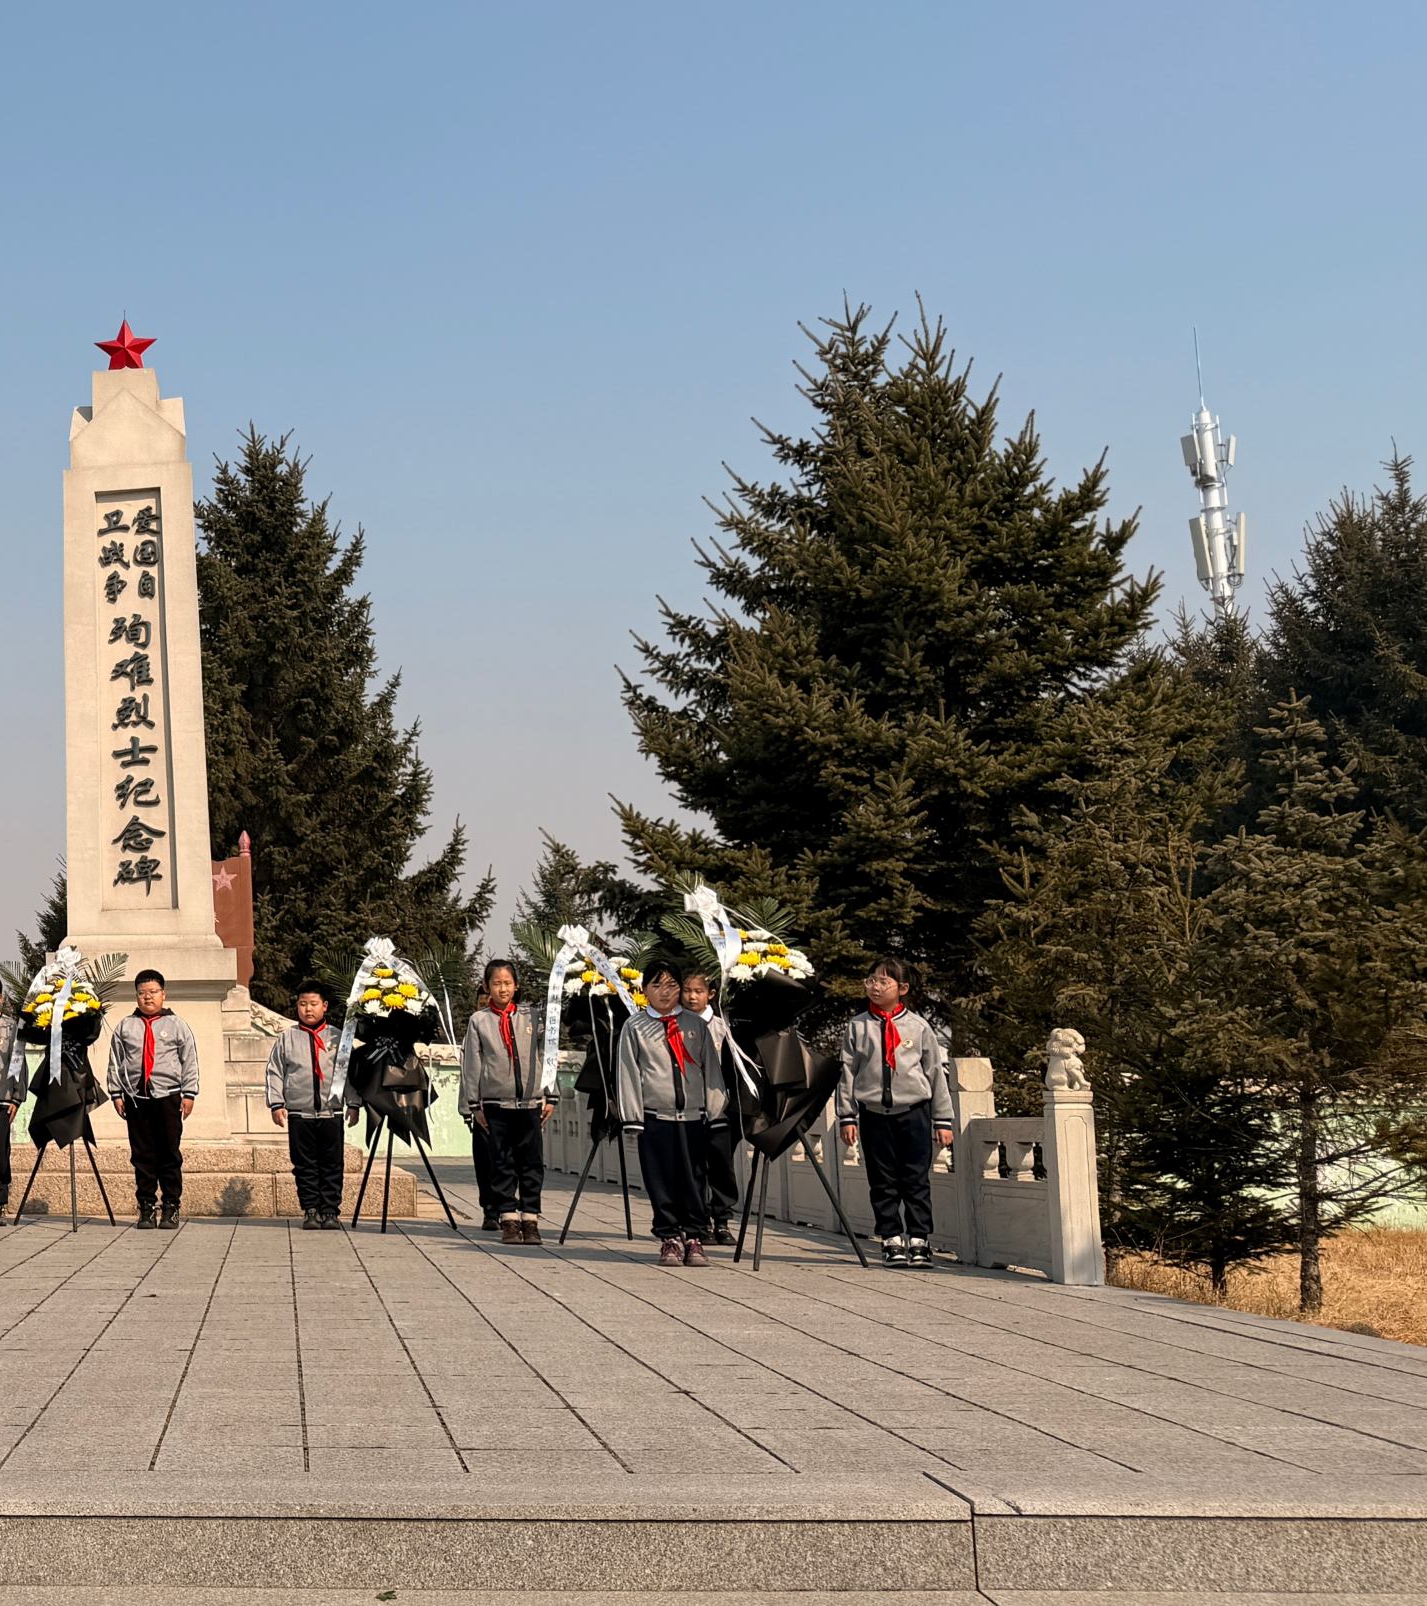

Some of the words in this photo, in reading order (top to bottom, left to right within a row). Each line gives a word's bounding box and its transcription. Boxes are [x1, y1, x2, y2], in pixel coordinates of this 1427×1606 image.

[108, 613, 166, 897] 殉难烈士纪念碑
